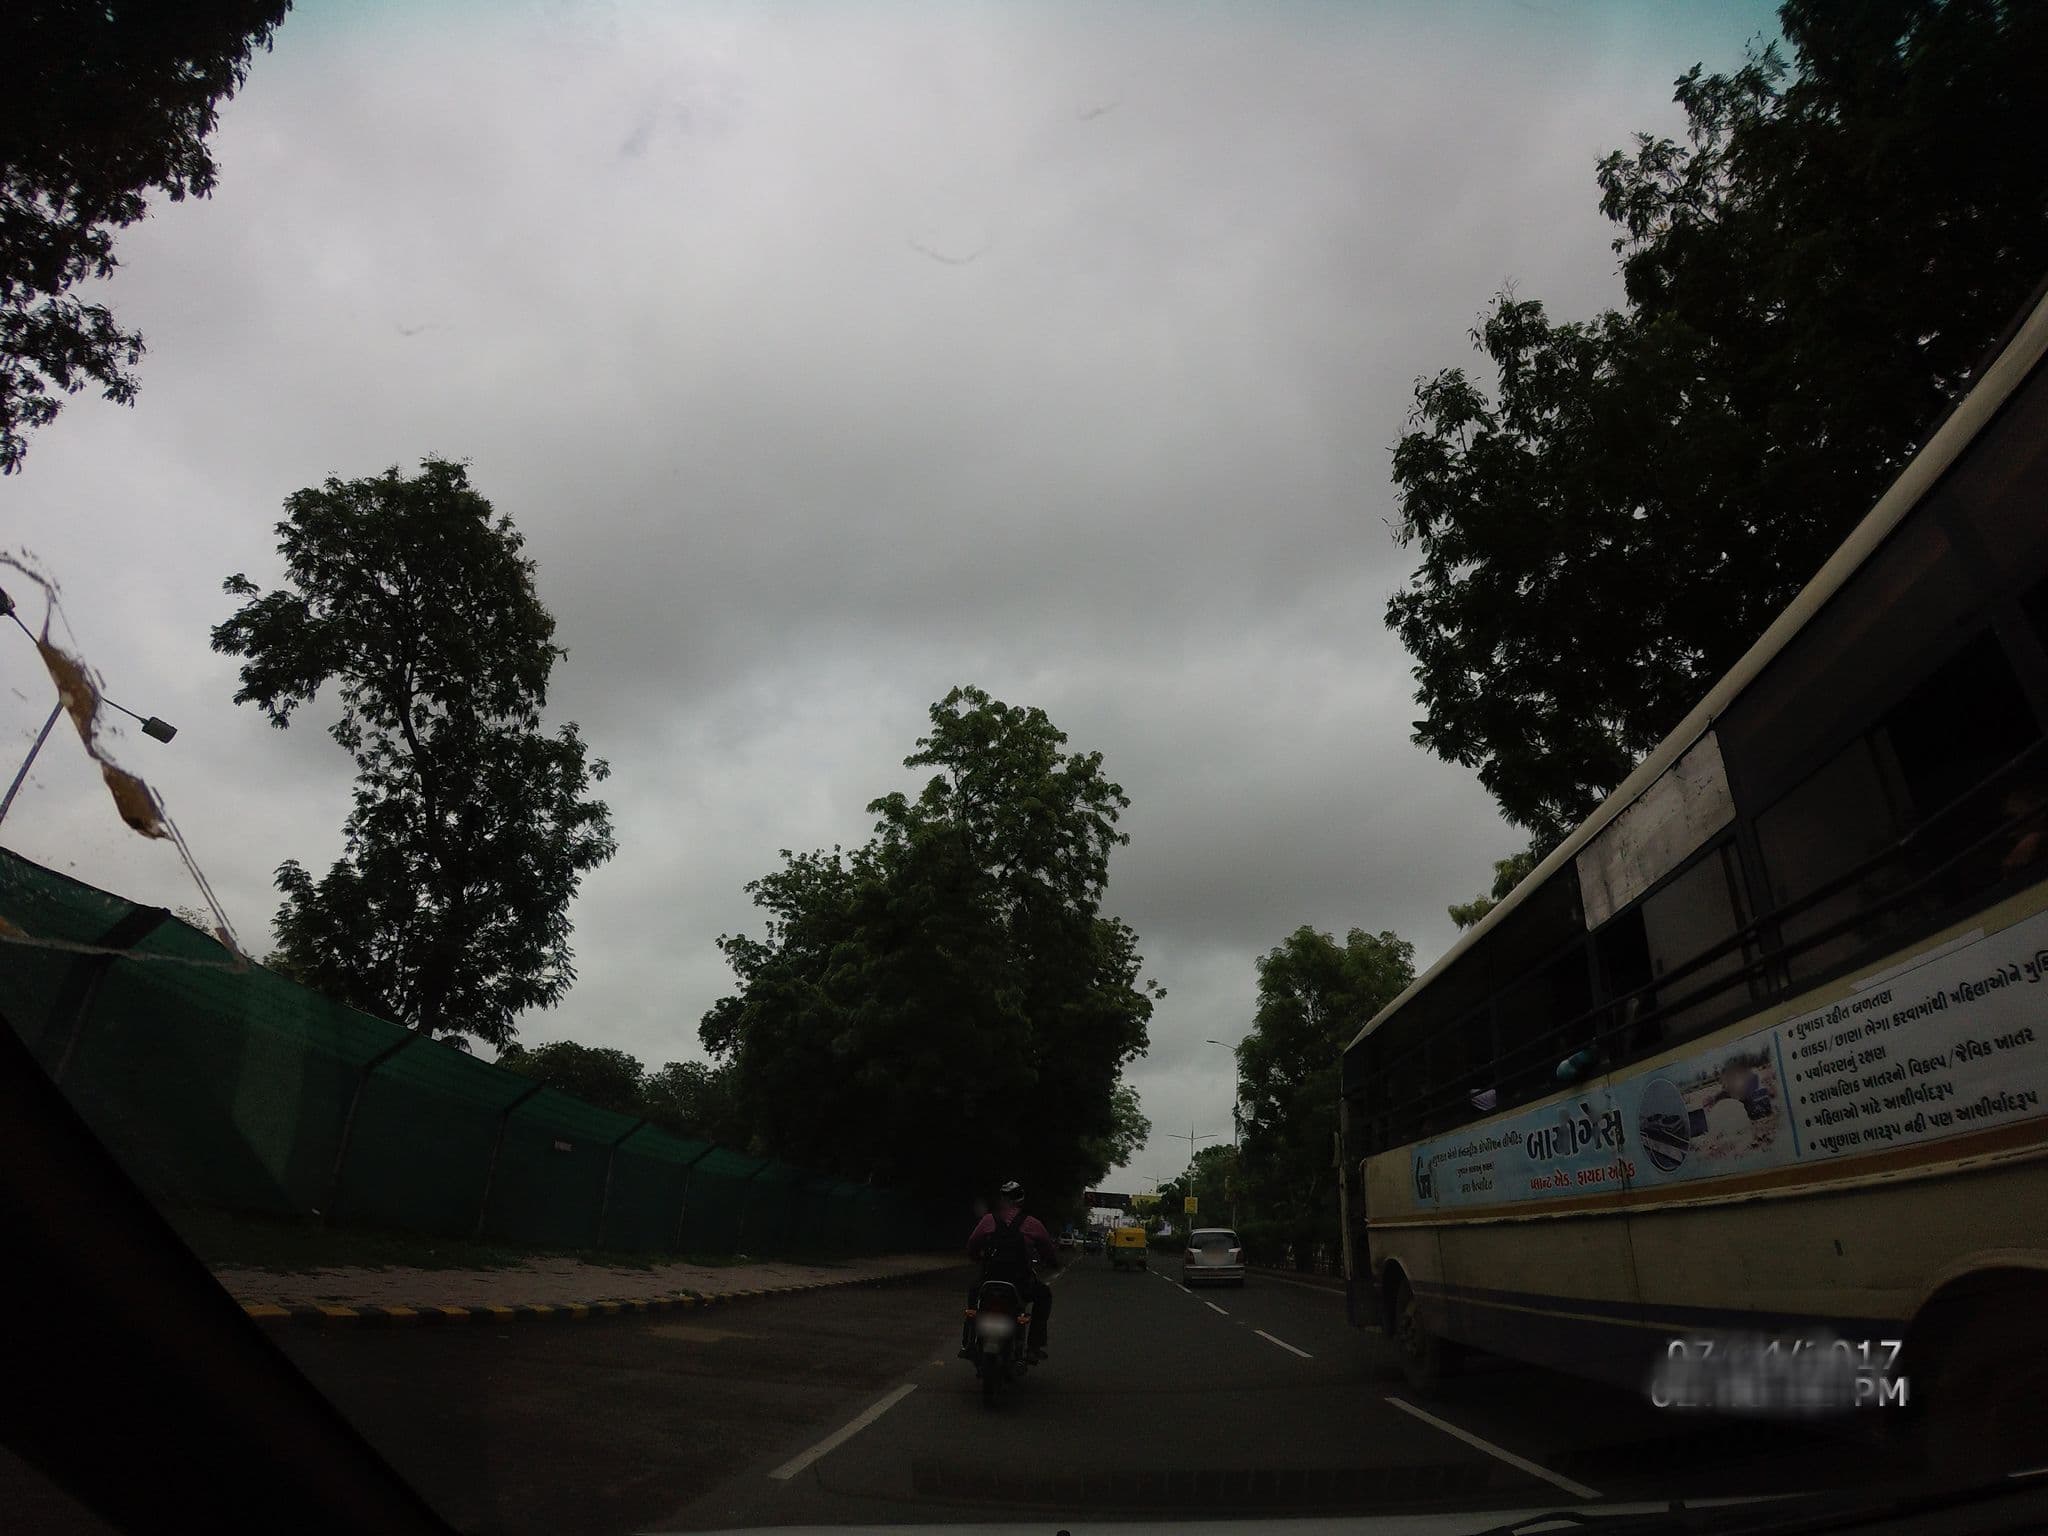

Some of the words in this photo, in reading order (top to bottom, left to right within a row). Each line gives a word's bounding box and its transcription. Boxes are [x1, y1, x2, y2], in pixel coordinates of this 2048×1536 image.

[1826, 1005, 1850, 1026] રહીત
[1852, 990, 1892, 1014] બળતણ
[1864, 1019, 1890, 1037] ભેગા
[1892, 991, 1949, 1027] કરવામાંથી
[1950, 964, 2021, 1005] મહિલાઓને
[1805, 1050, 1857, 1080] પર્યાવરણનું
[1859, 1046, 1886, 1066] રક્ષણ
[1810, 1079, 1860, 1104] રાસાયણિક
[1863, 1064, 1906, 1089] ખાતરનો
[1994, 1027, 2035, 1050] ખાતર
[1814, 1102, 1859, 1127] મહિલાઓ
[1860, 1099, 1881, 1116] માટે
[1820, 1131, 1861, 1153] પશુછાણ
[1863, 1124, 1901, 1142] ભારરૂપ
[1930, 1112, 1952, 1126] પણ
[1577, 1166, 1606, 1185] ફાયદા
